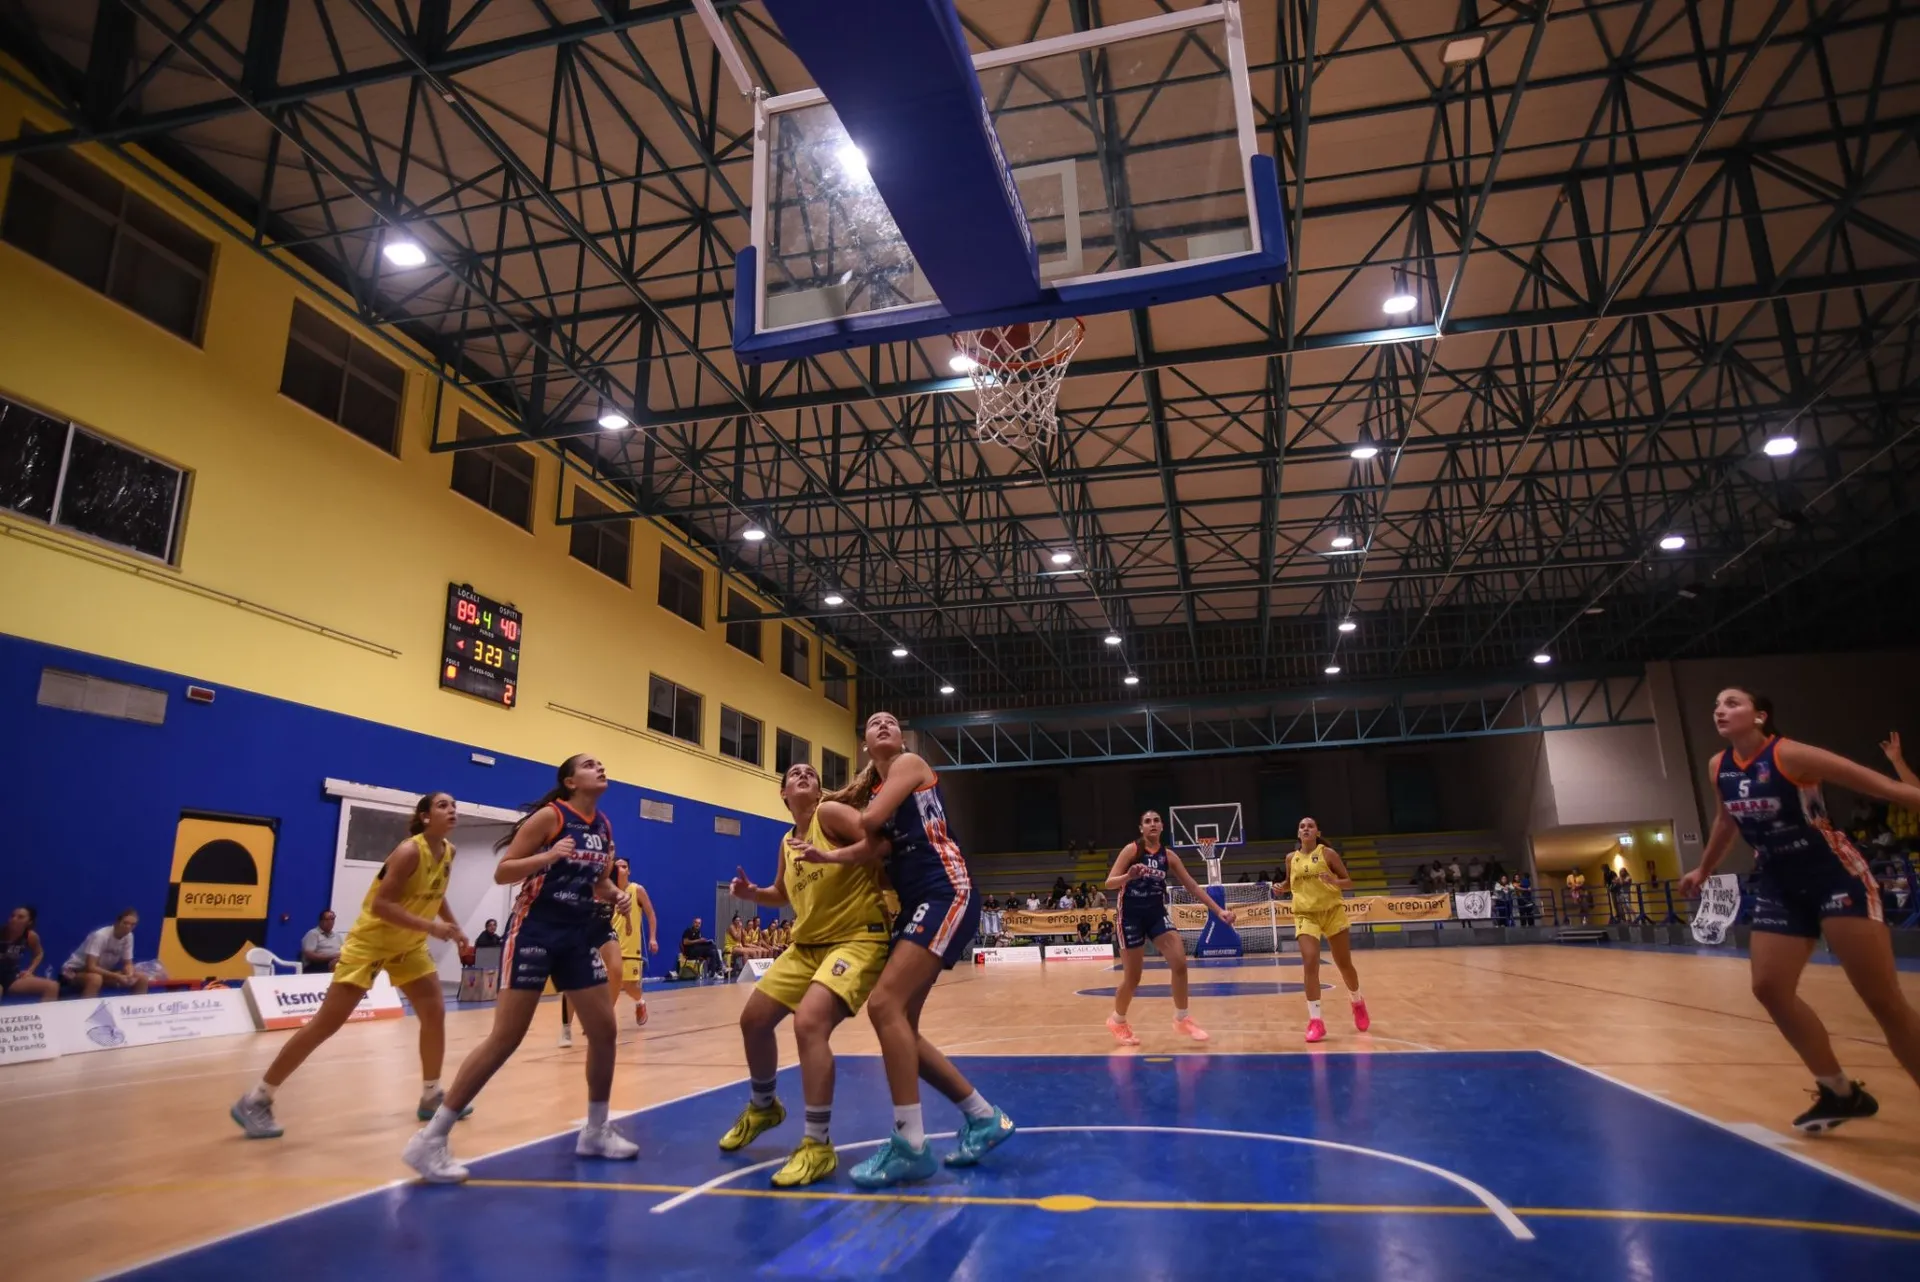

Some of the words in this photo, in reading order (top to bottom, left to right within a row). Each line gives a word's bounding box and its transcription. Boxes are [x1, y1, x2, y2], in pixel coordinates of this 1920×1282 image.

[457, 588, 480, 603] LOCALI
[457, 600, 476, 624] 89
[483, 611, 492, 630] 4
[499, 606, 518, 619] OSPITI
[500, 617, 517, 640] 40
[503, 684, 513, 704] 2
[1738, 779, 1751, 798] 5
[583, 832, 603, 850] 30
[1147, 858, 1158, 868] 10
[119, 1005, 155, 1015] Marco
[8, 1043, 47, 1052] Taranto
